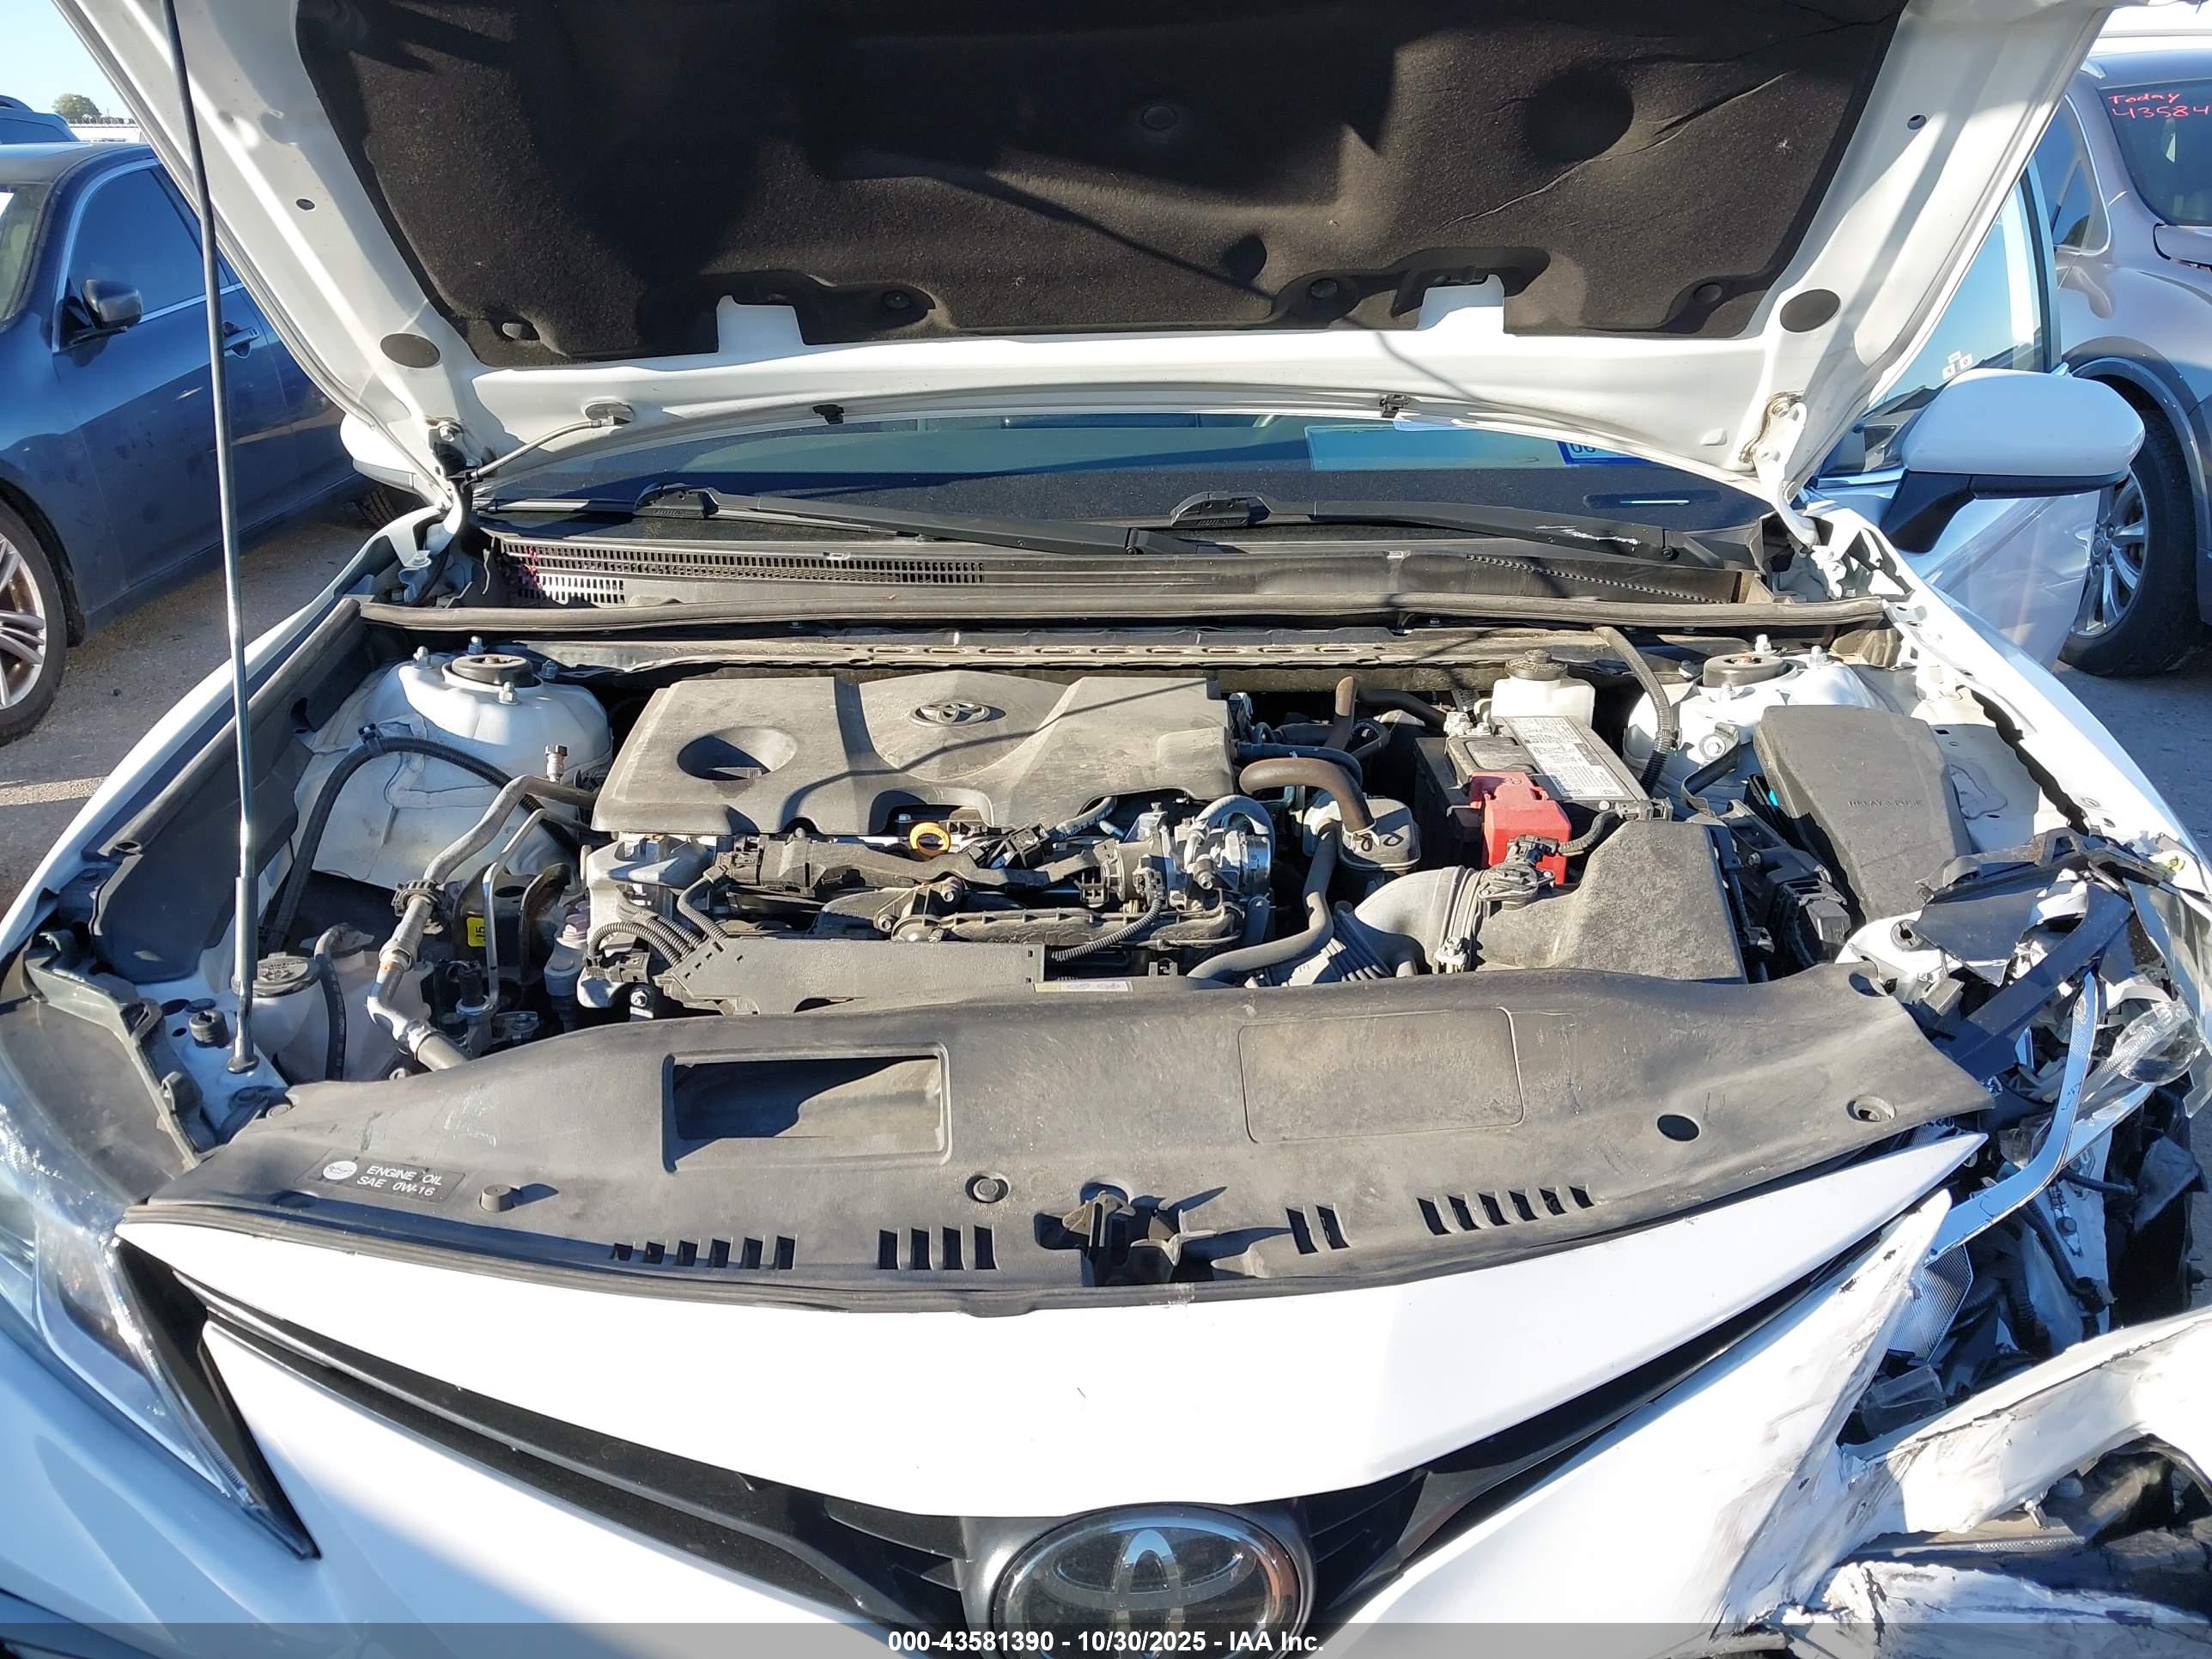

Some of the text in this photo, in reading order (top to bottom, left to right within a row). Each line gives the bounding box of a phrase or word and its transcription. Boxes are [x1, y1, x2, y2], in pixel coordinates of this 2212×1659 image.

[2108, 92, 2181, 105] Today
[366, 1164, 443, 1186] ENGINE OIL
[356, 1176, 436, 1197] SAE 0W-16
